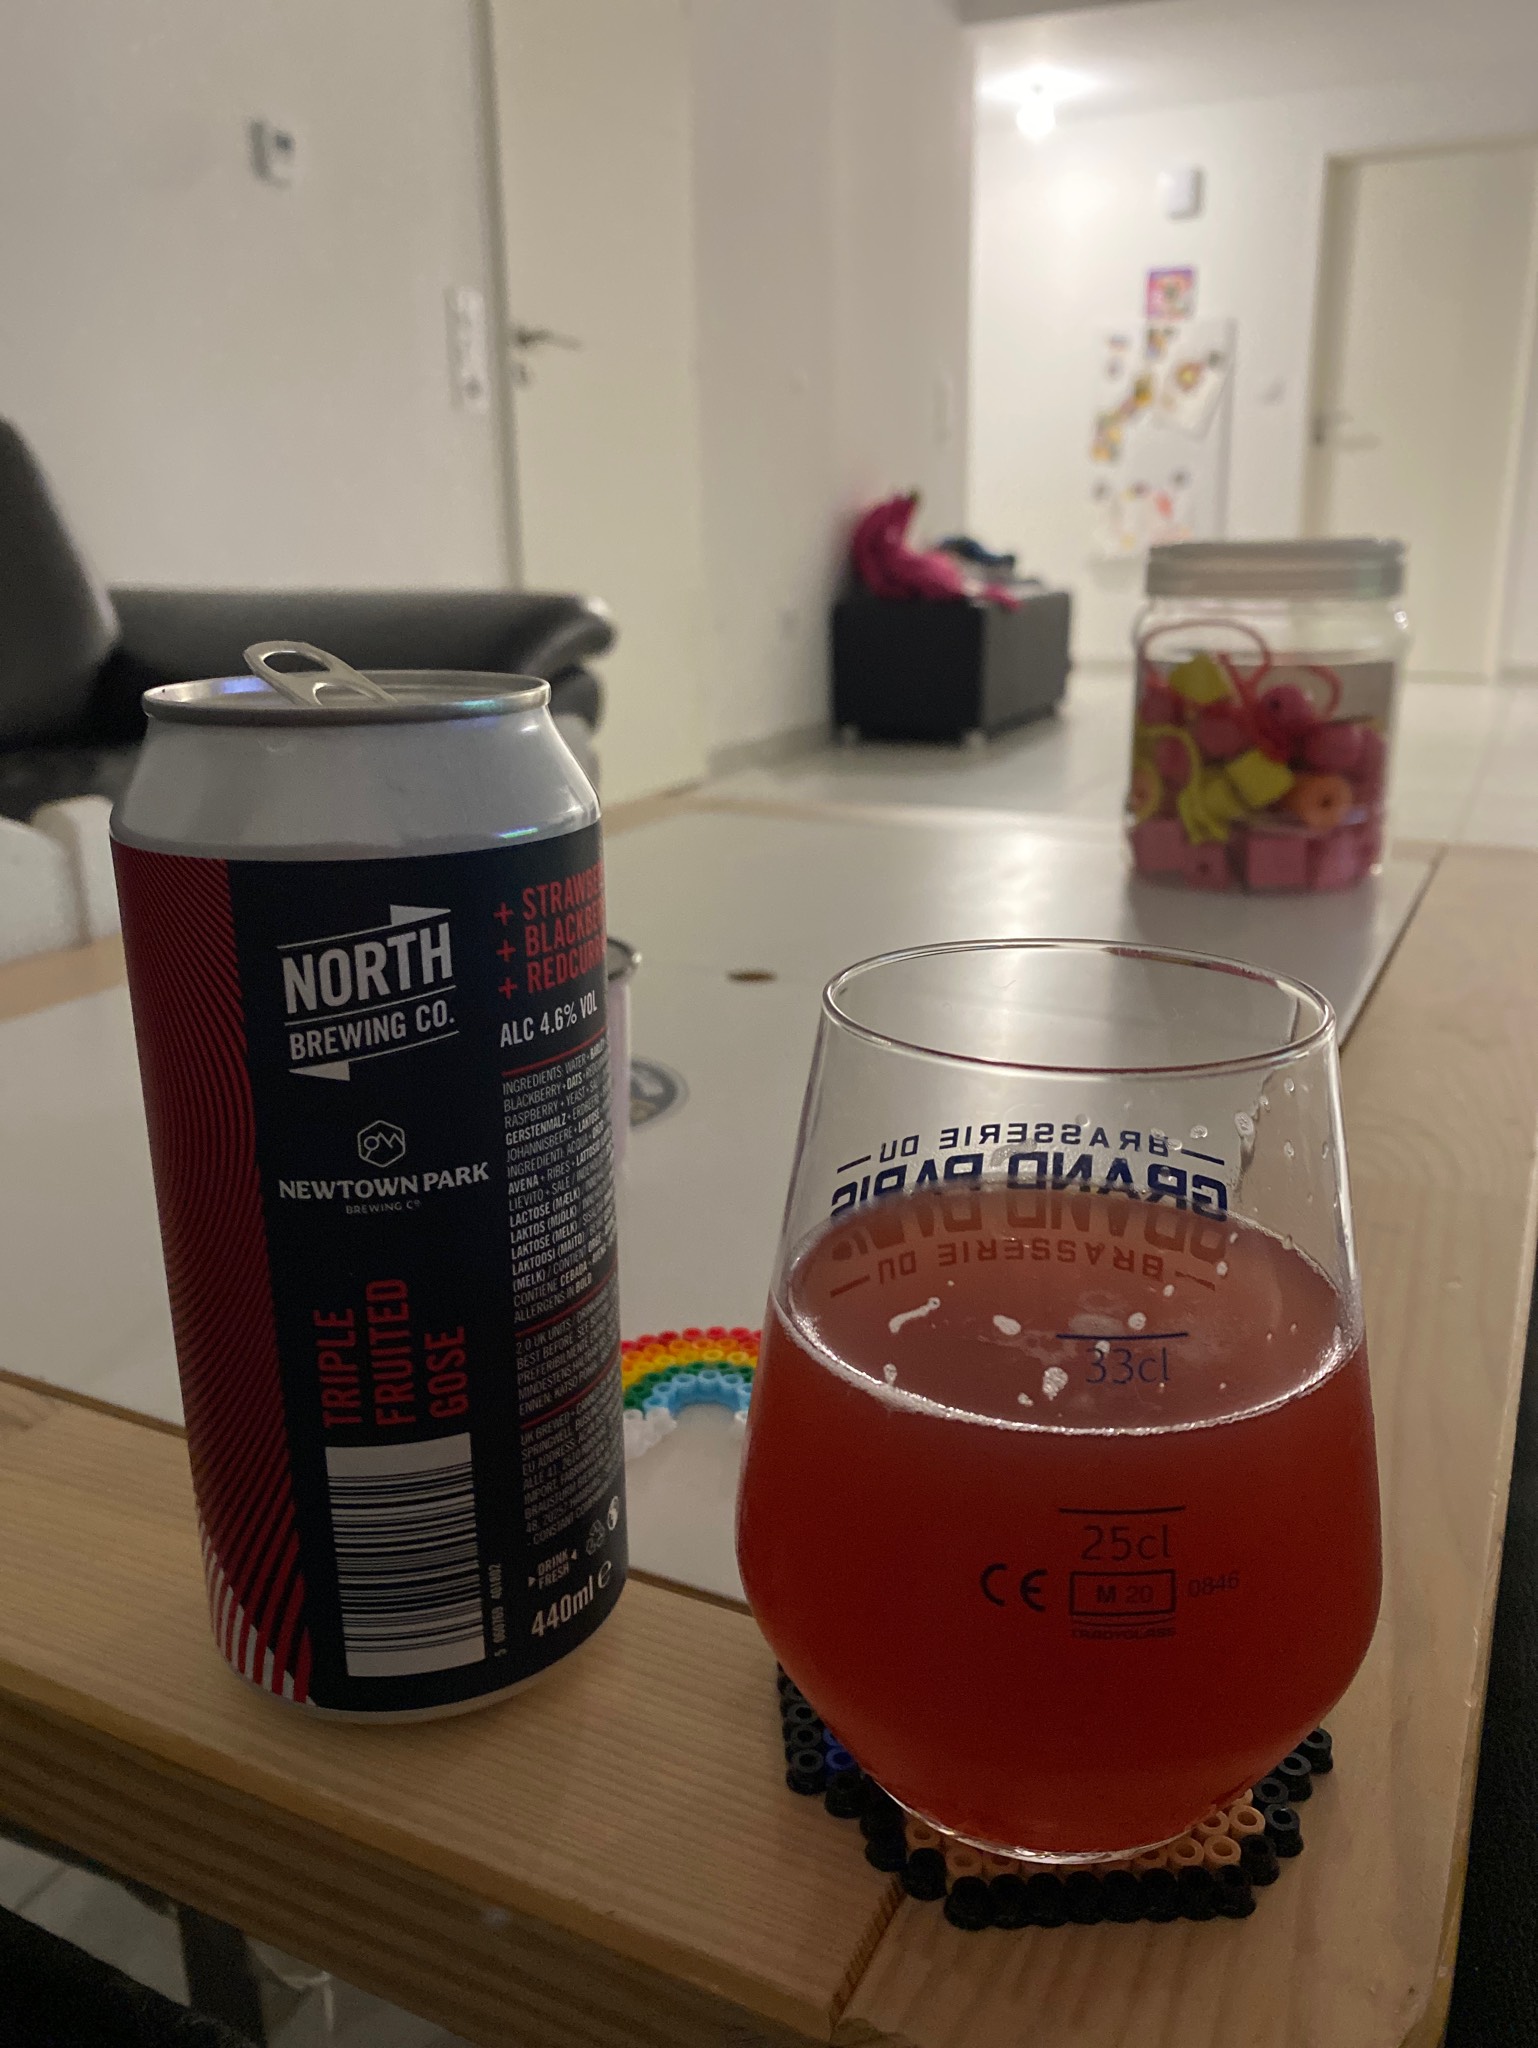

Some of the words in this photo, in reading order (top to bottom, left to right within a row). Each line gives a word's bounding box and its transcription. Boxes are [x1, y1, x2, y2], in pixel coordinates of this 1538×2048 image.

[282, 922, 453, 1015] NORTH
[289, 1011, 406, 1061] BREWING
[415, 1000, 455, 1034] CO.
[500, 1017, 534, 1048] ALC
[540, 1001, 578, 1036] 4.6%
[580, 990, 598, 1019] VOL
[503, 1082, 562, 1113] BLACKBERRY
[566, 1072, 583, 1090] OATS
[504, 1101, 559, 1130] RASPBERRY
[505, 1113, 567, 1146] GERSTENMALZ
[278, 1175, 418, 1199] NEWTOWN
[423, 1162, 489, 1192] PARK
[508, 1174, 539, 1196] AVENA
[547, 1160, 571, 1181] RIBES
[509, 1189, 544, 1212] LIEVITO
[551, 1176, 571, 1196] SALE
[346, 1201, 402, 1214] BREWING
[510, 1202, 551, 1228] LACTOSE
[510, 1220, 545, 1244] LAKTOS
[511, 1234, 551, 1260] LAKTOSE
[512, 1248, 556, 1276] LAKTOOSI
[513, 1269, 546, 1293] (MELK)
[312, 1308, 363, 1429] TRIPLE
[365, 1279, 417, 1427] FRUITED
[1085, 1347, 1170, 1384] 33cl
[424, 1325, 469, 1419] GOSE
[1081, 1524, 1171, 1561] 25cl
[537, 1548, 569, 1577] DRINK
[538, 1562, 570, 1590] FRESH
[531, 1575, 595, 1638] 440ml
